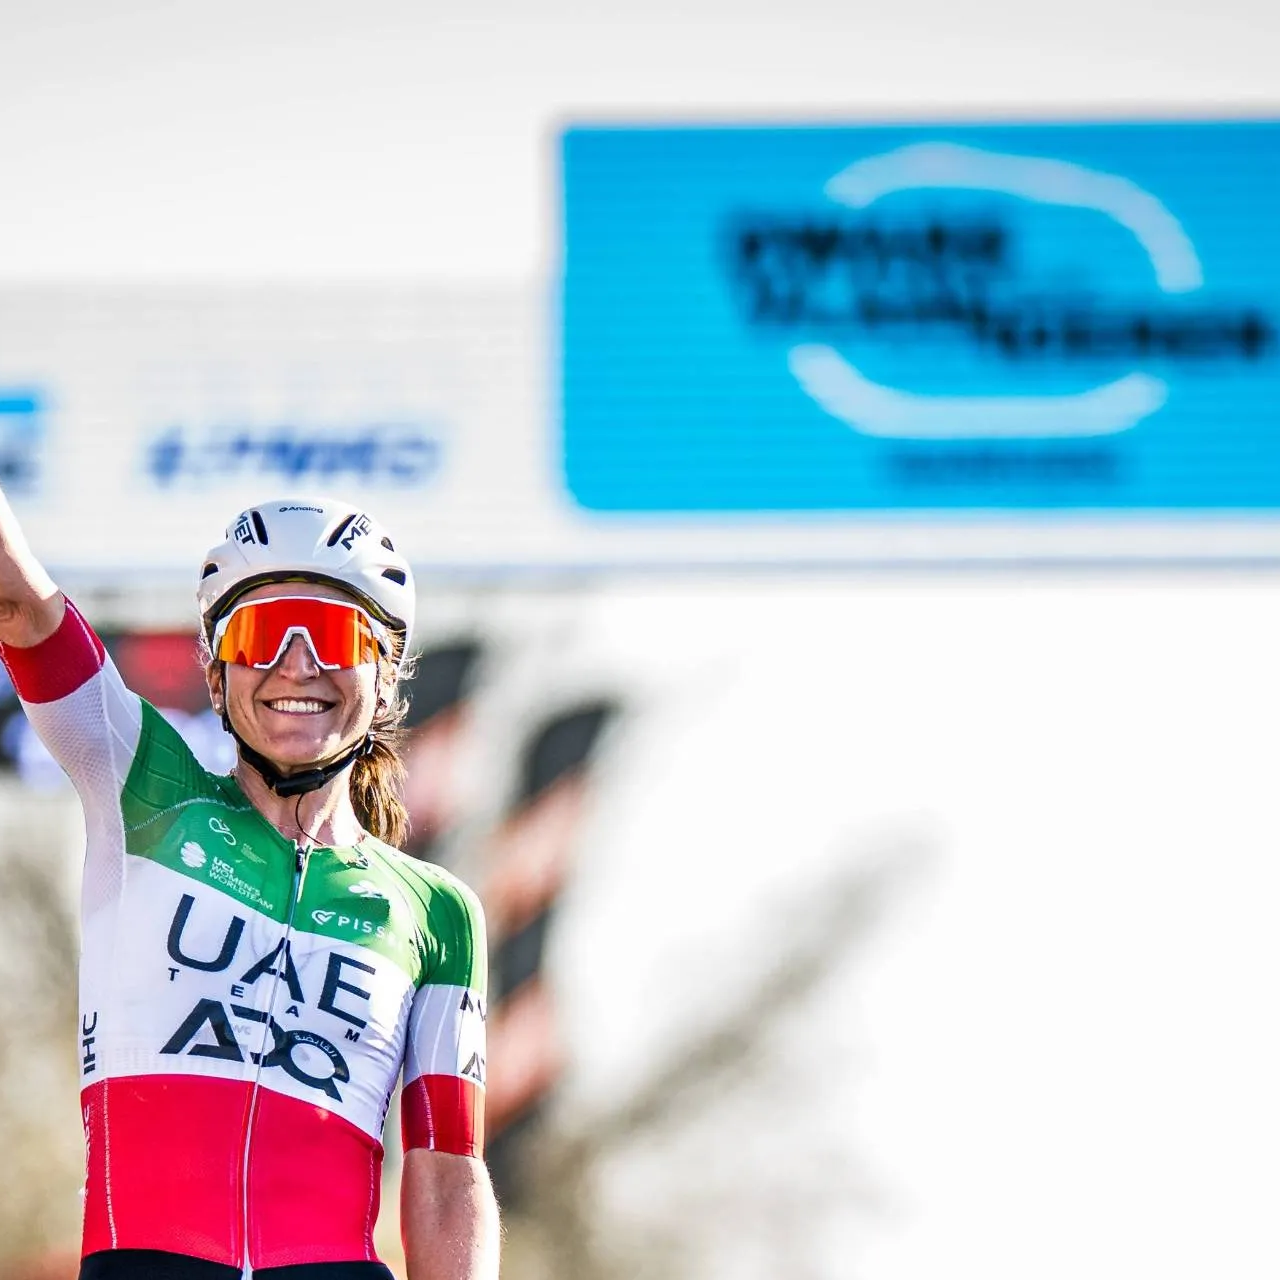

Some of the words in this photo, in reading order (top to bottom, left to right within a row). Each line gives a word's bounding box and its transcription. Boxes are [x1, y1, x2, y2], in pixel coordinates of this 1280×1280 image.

[288, 506, 324, 514] Analog
[211, 864, 261, 896] WOMEN'S
[213, 856, 235, 874] UCI
[209, 870, 274, 910] WORLDTEAM
[167, 893, 376, 1029] UAE
[83, 1011, 98, 1075] IHC
[159, 998, 350, 1103] ADQ
